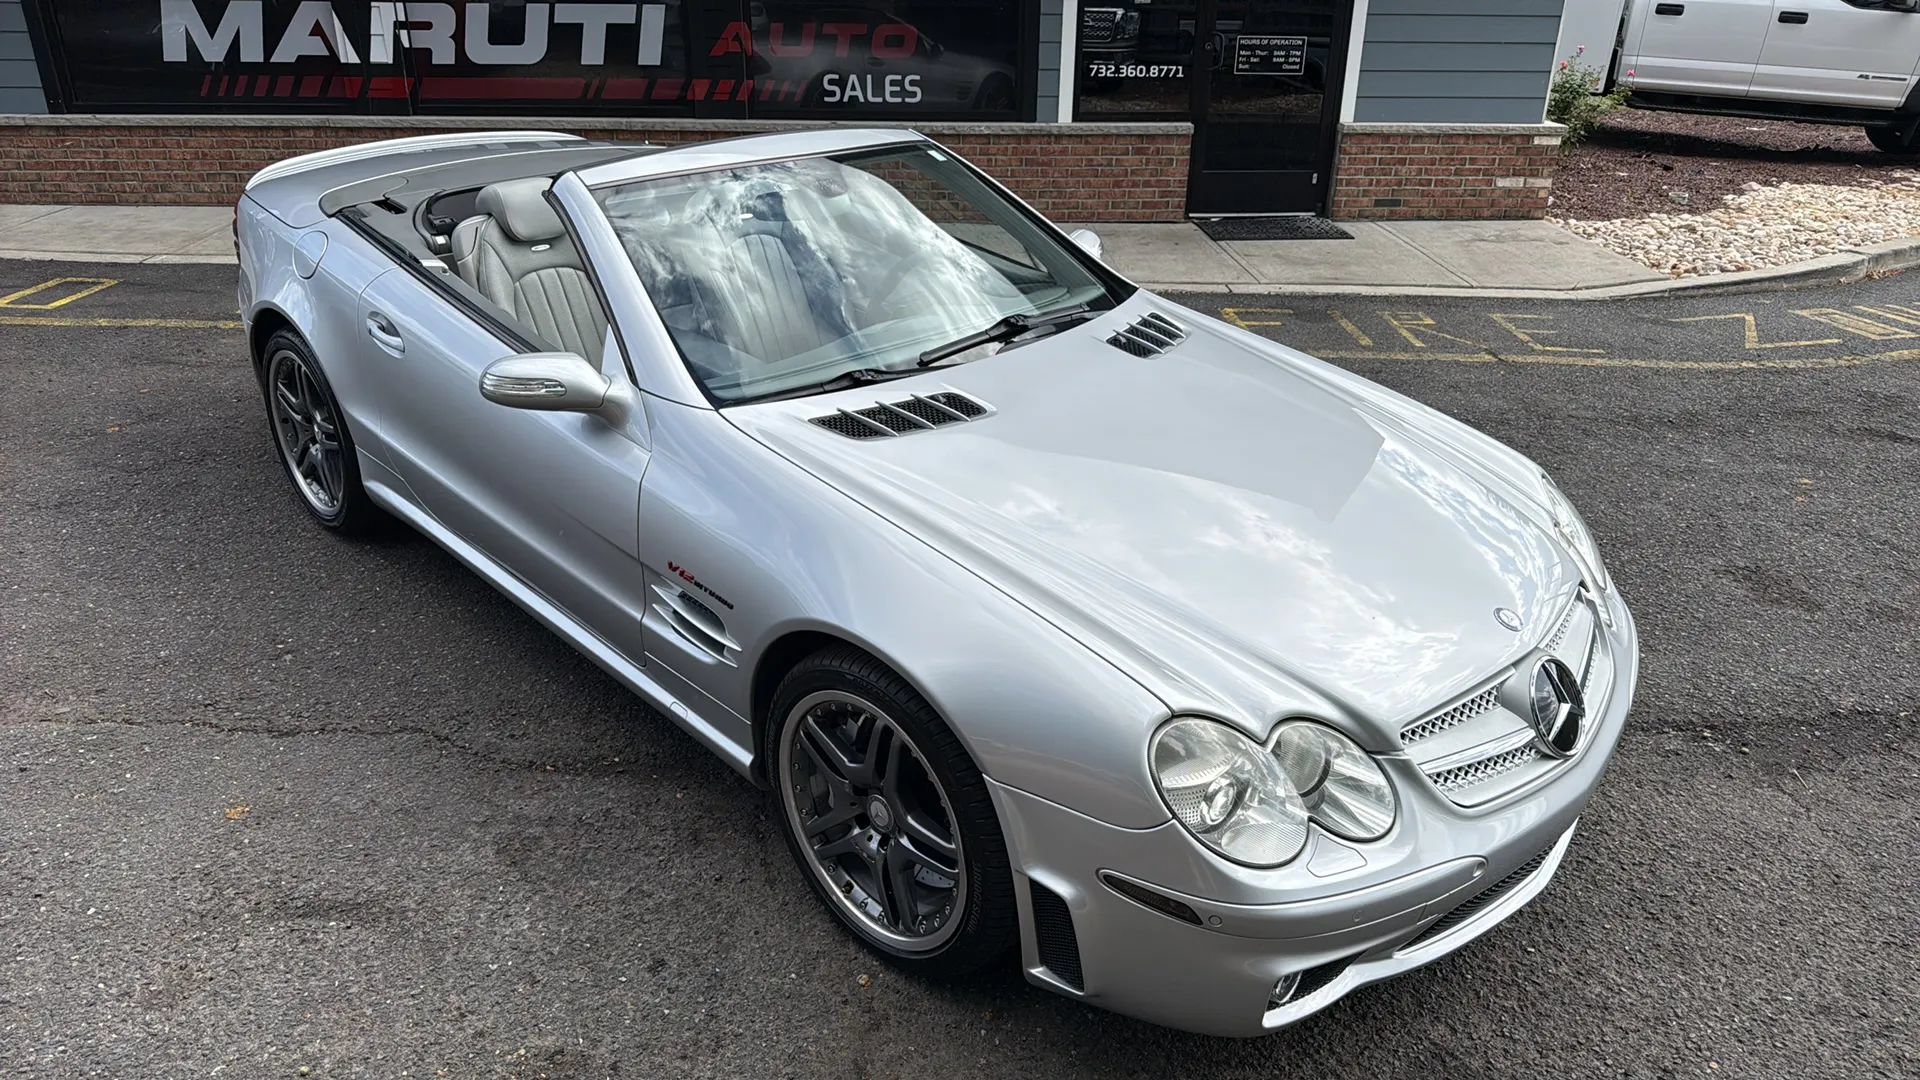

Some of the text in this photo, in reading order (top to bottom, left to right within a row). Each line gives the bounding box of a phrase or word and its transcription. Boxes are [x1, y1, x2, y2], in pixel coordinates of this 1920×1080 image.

[161, 0, 666, 65] MARUTI
[709, 21, 919, 58] AUTO
[822, 73, 923, 103] SALES
[1089, 65, 1185, 78] 732.360.8771
